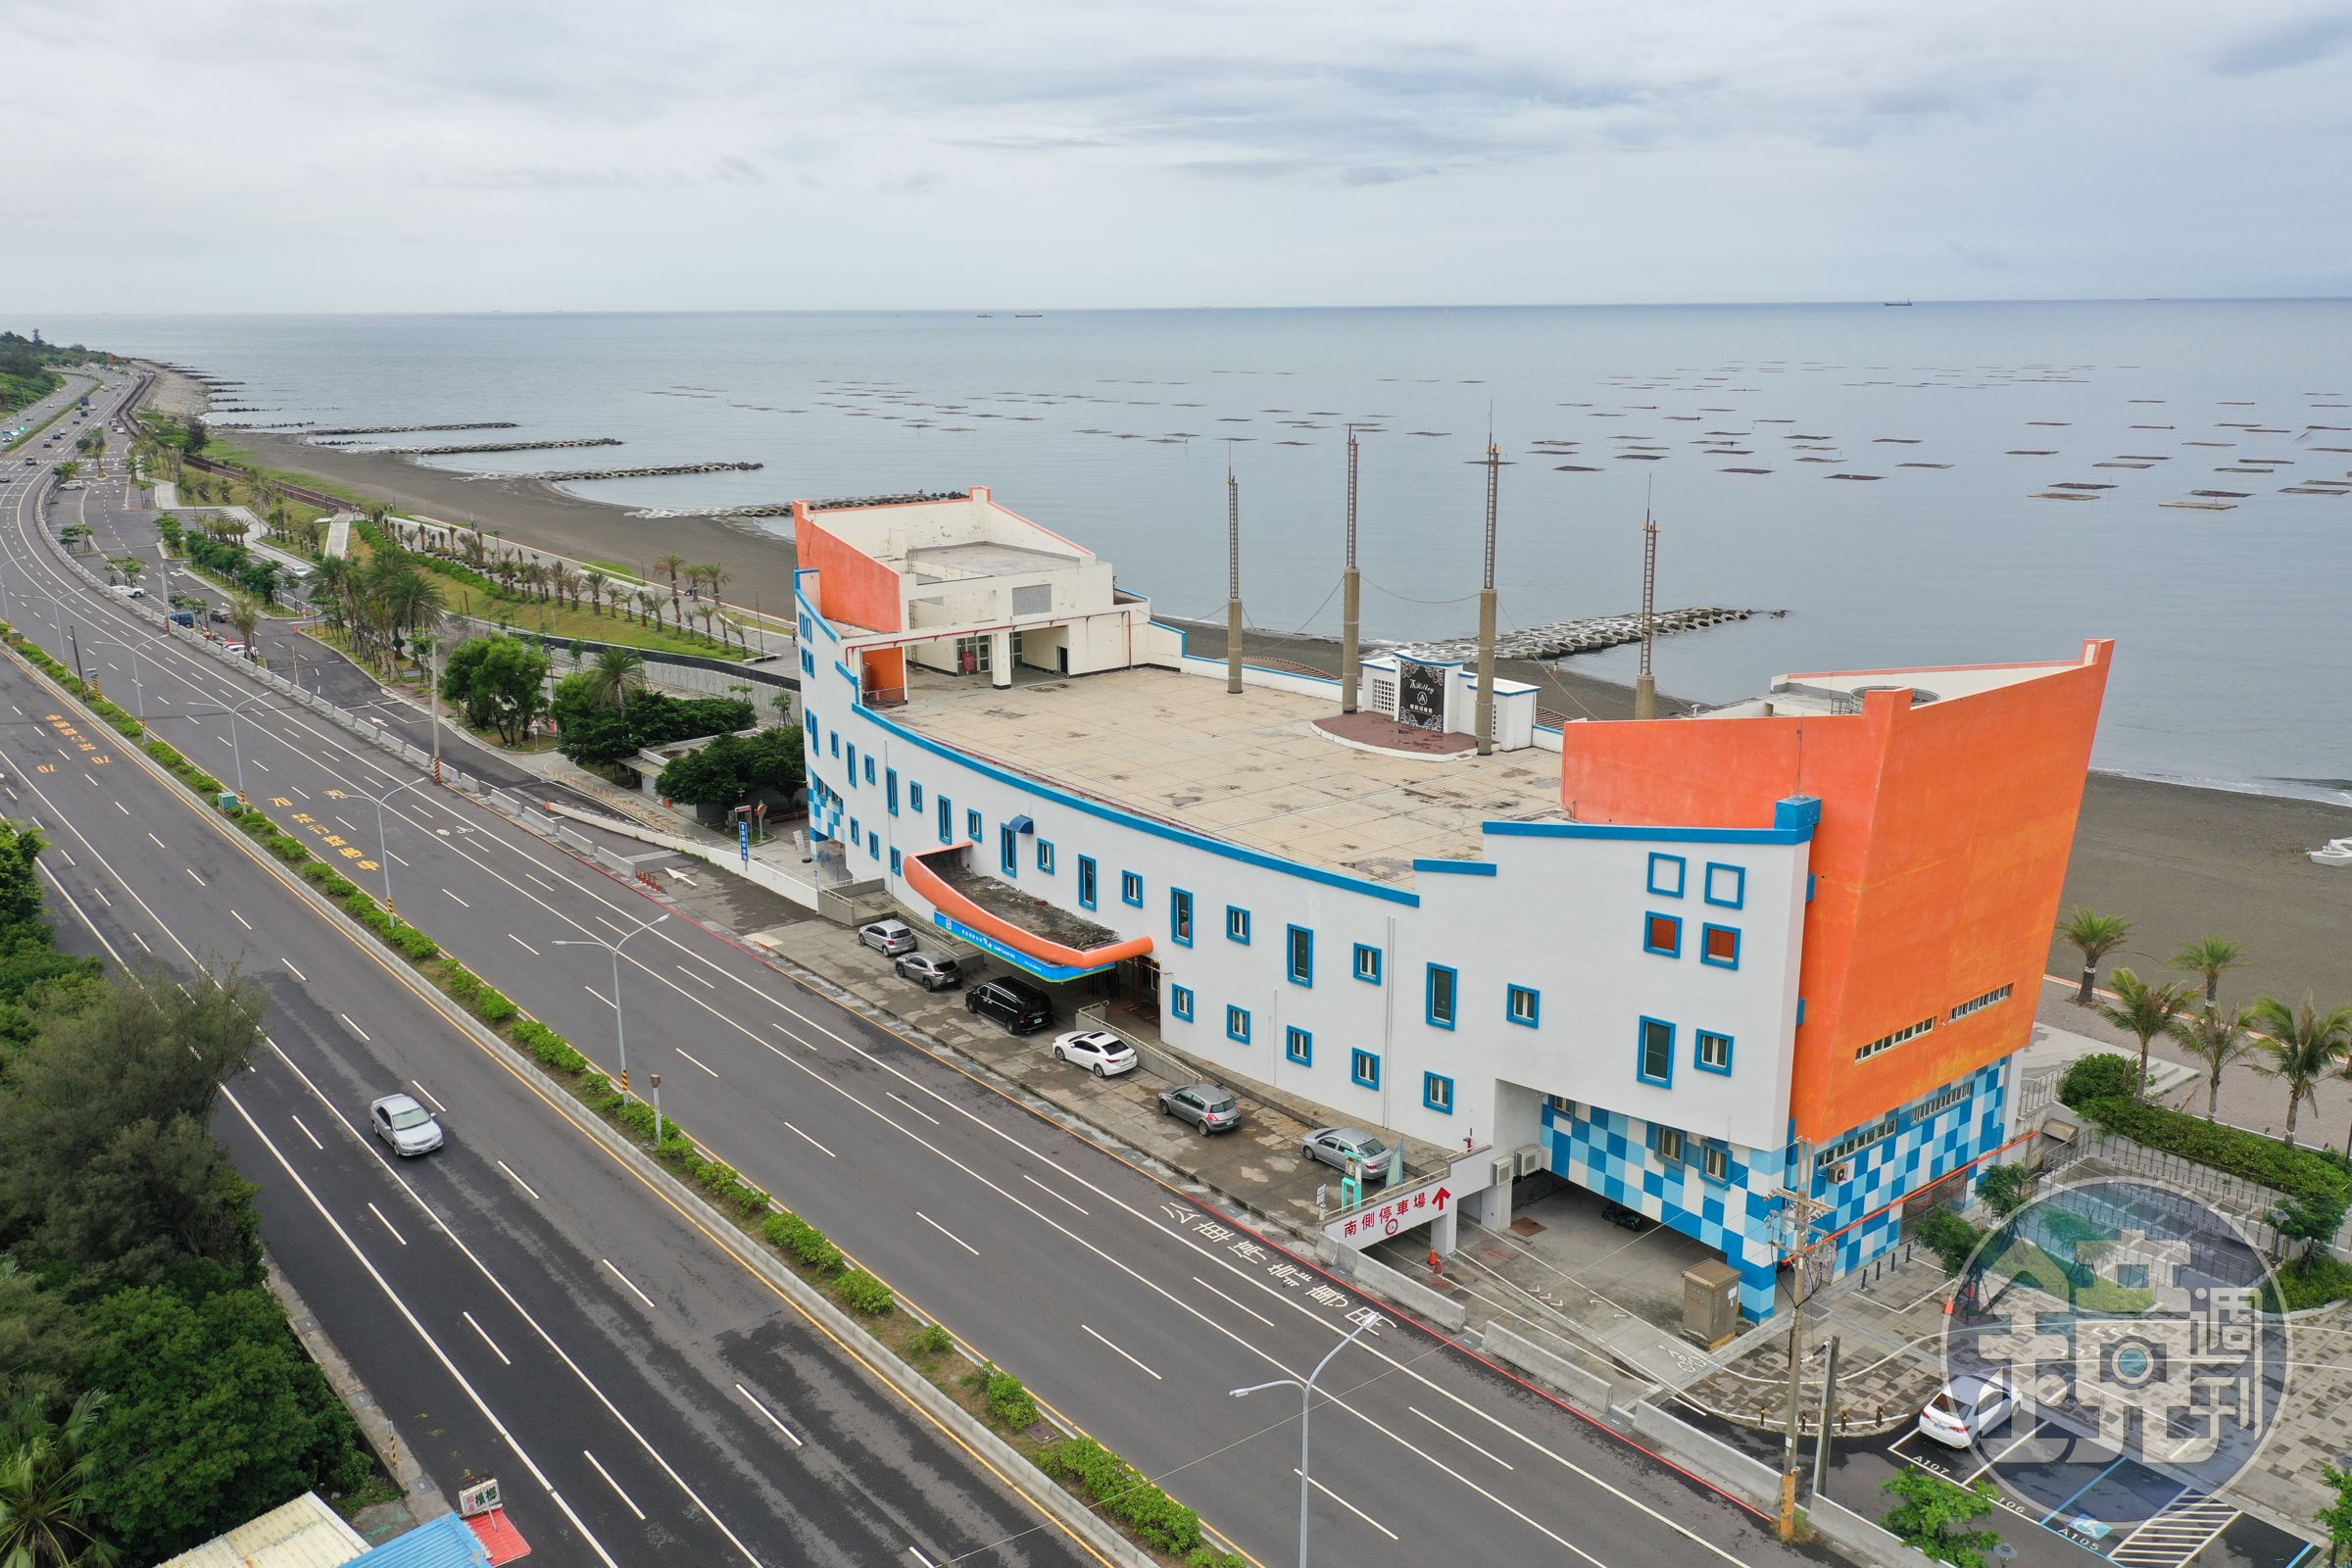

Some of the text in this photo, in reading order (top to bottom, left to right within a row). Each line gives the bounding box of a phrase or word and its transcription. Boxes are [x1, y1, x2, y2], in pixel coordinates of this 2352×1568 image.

[37, 764, 60, 773] 70
[91, 755, 113, 764] 70
[268, 797, 292, 807] 70
[1344, 1192, 1425, 1238] 南側停車場
[1160, 1202, 1396, 1336] 公車停靠專用
[1913, 1455, 1950, 1474] A107
[2058, 1527, 2101, 1551] A105
